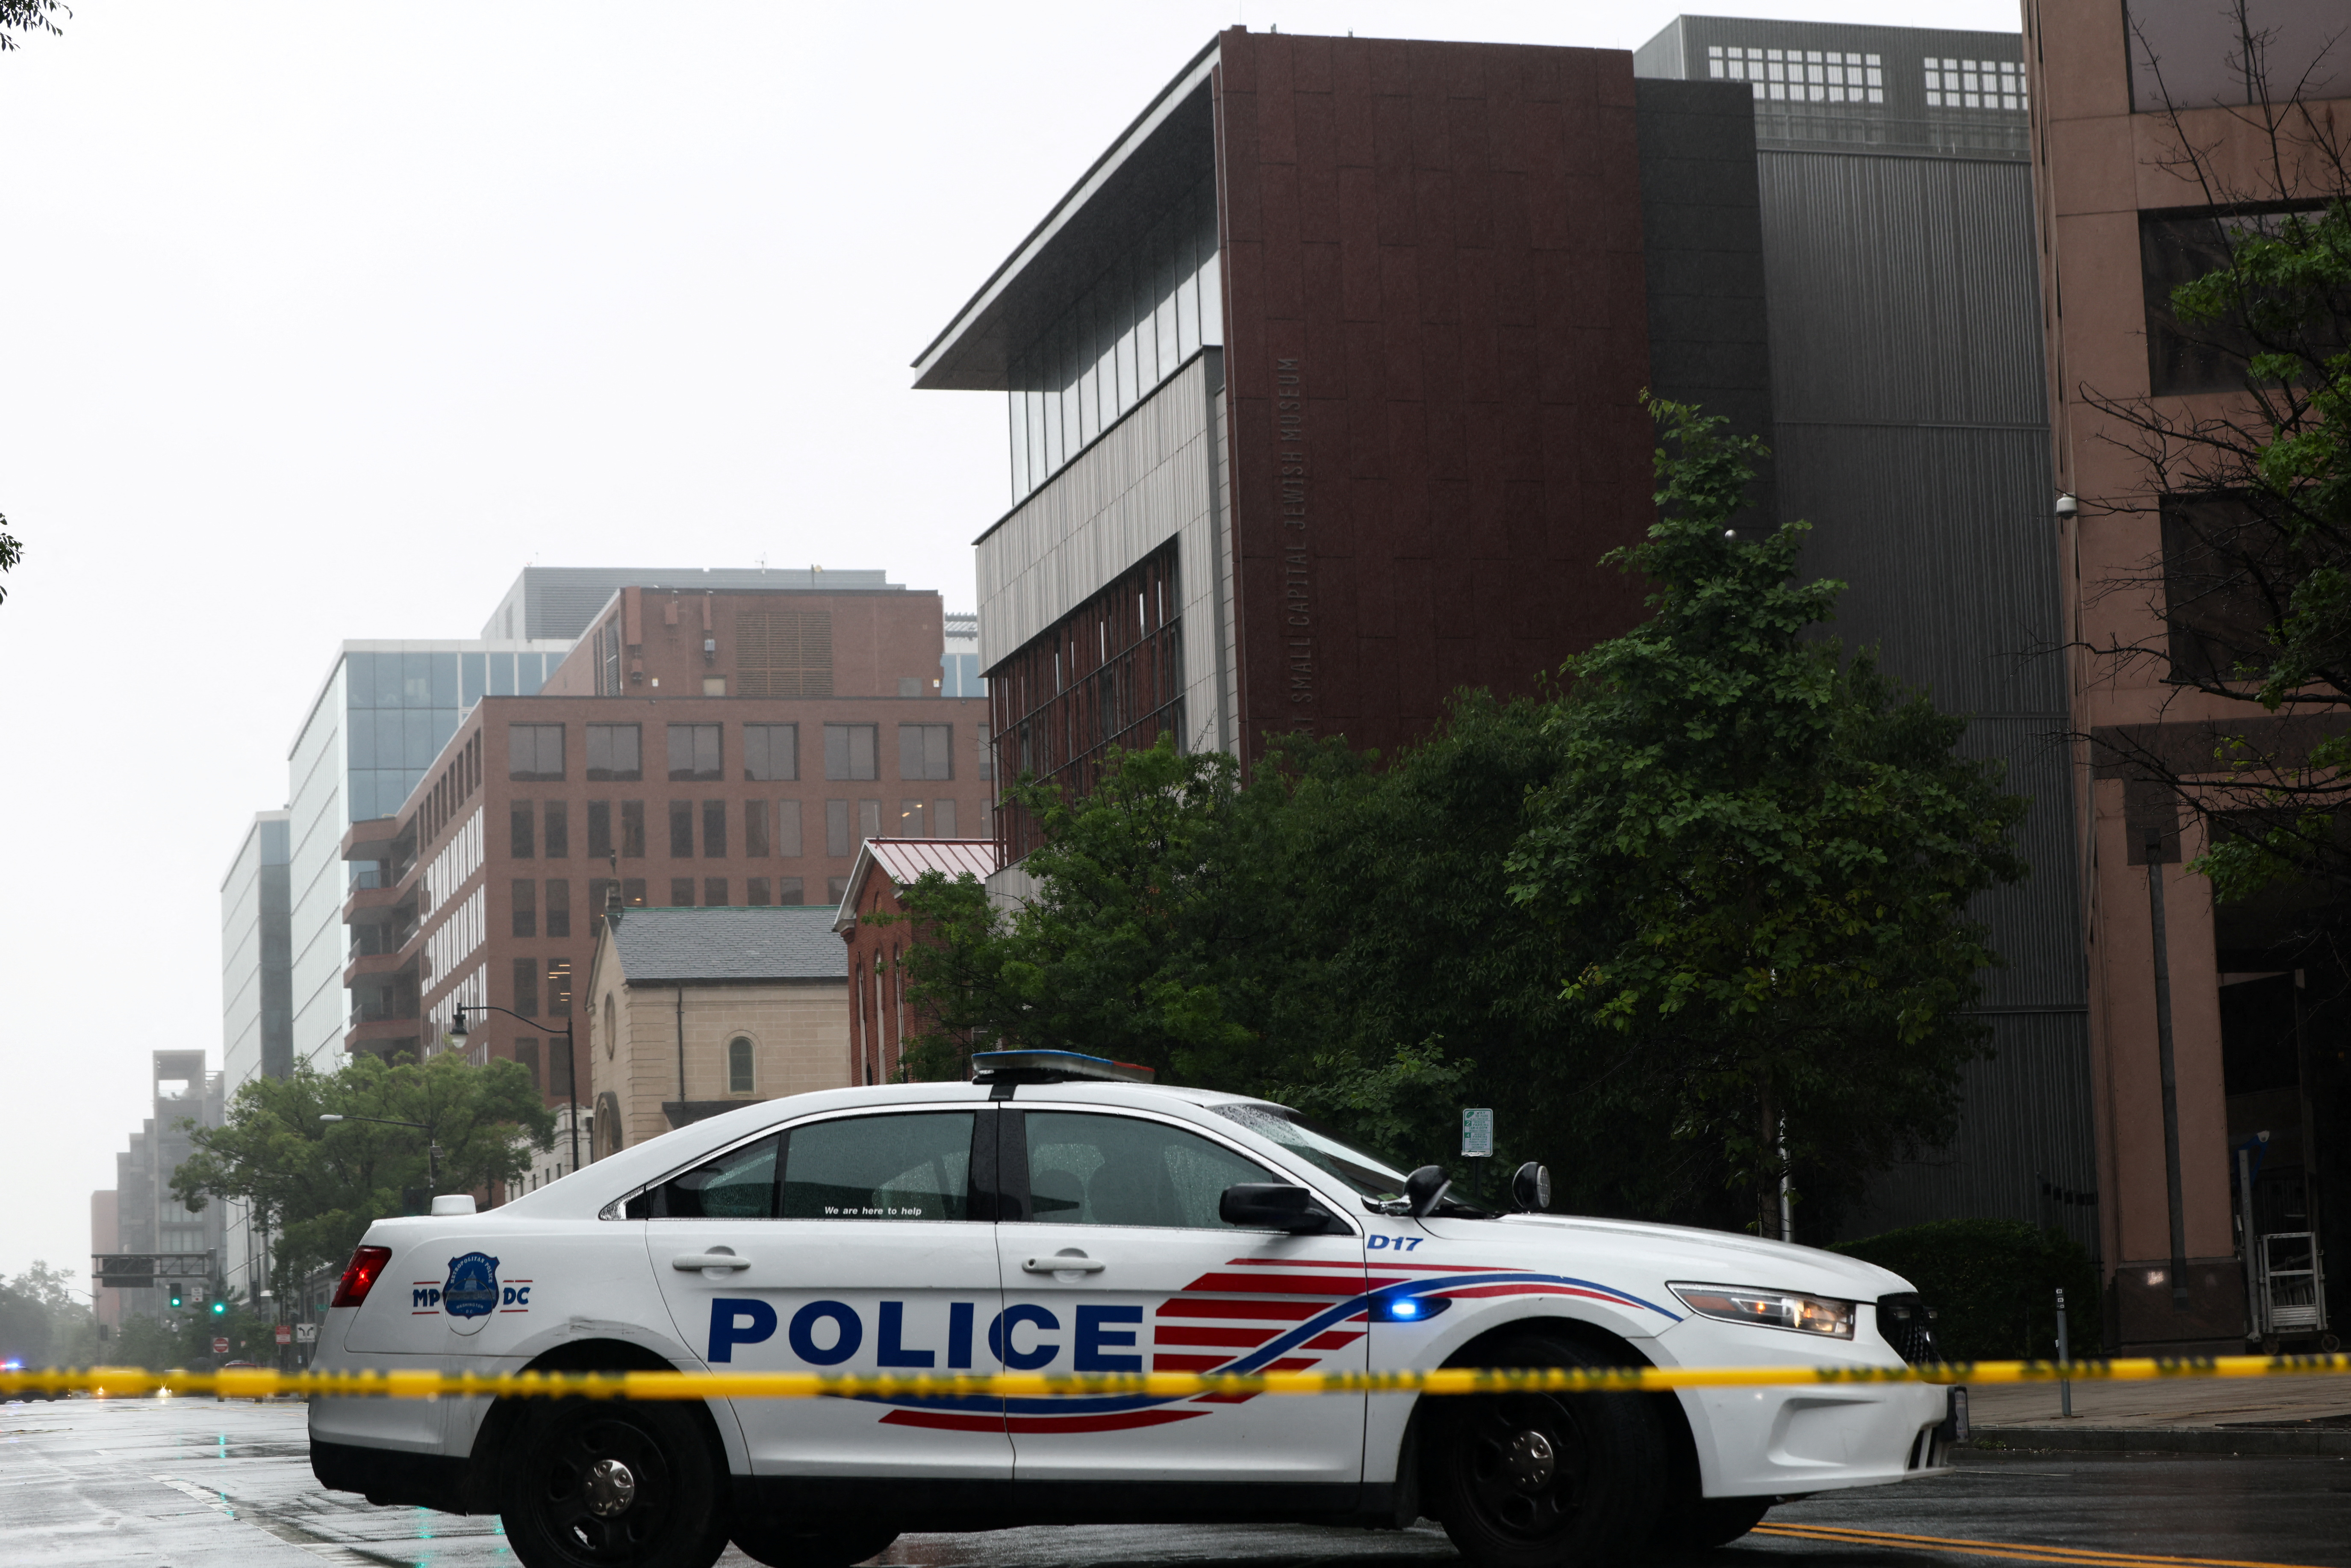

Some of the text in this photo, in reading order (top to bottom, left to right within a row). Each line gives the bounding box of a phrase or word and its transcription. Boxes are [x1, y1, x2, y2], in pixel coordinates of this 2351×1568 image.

[1277, 358, 1303, 441] MUSEUM
[1282, 451, 1306, 530] JEWISH
[1286, 541, 1310, 626] CAPITAL
[1290, 637, 1313, 703] SMALL
[825, 1206, 839, 1214] We
[901, 1207, 922, 1216] help
[1367, 1234, 1424, 1251] D17
[451, 1256, 493, 1284] METROPOLITAN POLICE
[412, 1288, 440, 1307] MP
[503, 1287, 530, 1305] DC
[707, 1297, 1143, 1373] POLICE
